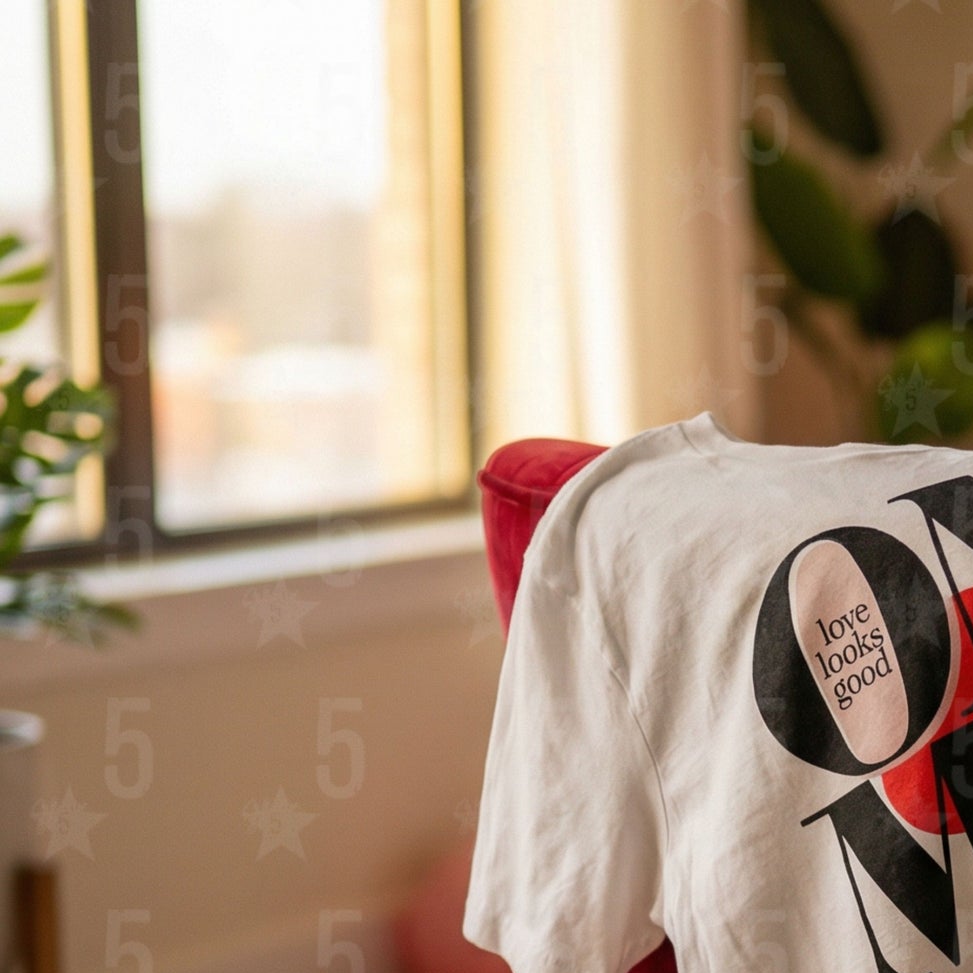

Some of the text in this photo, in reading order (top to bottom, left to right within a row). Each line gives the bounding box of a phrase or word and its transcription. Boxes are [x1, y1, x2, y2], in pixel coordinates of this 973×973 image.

[816, 603, 870, 646] love
[815, 628, 884, 680] looks
[834, 646, 893, 710] good
